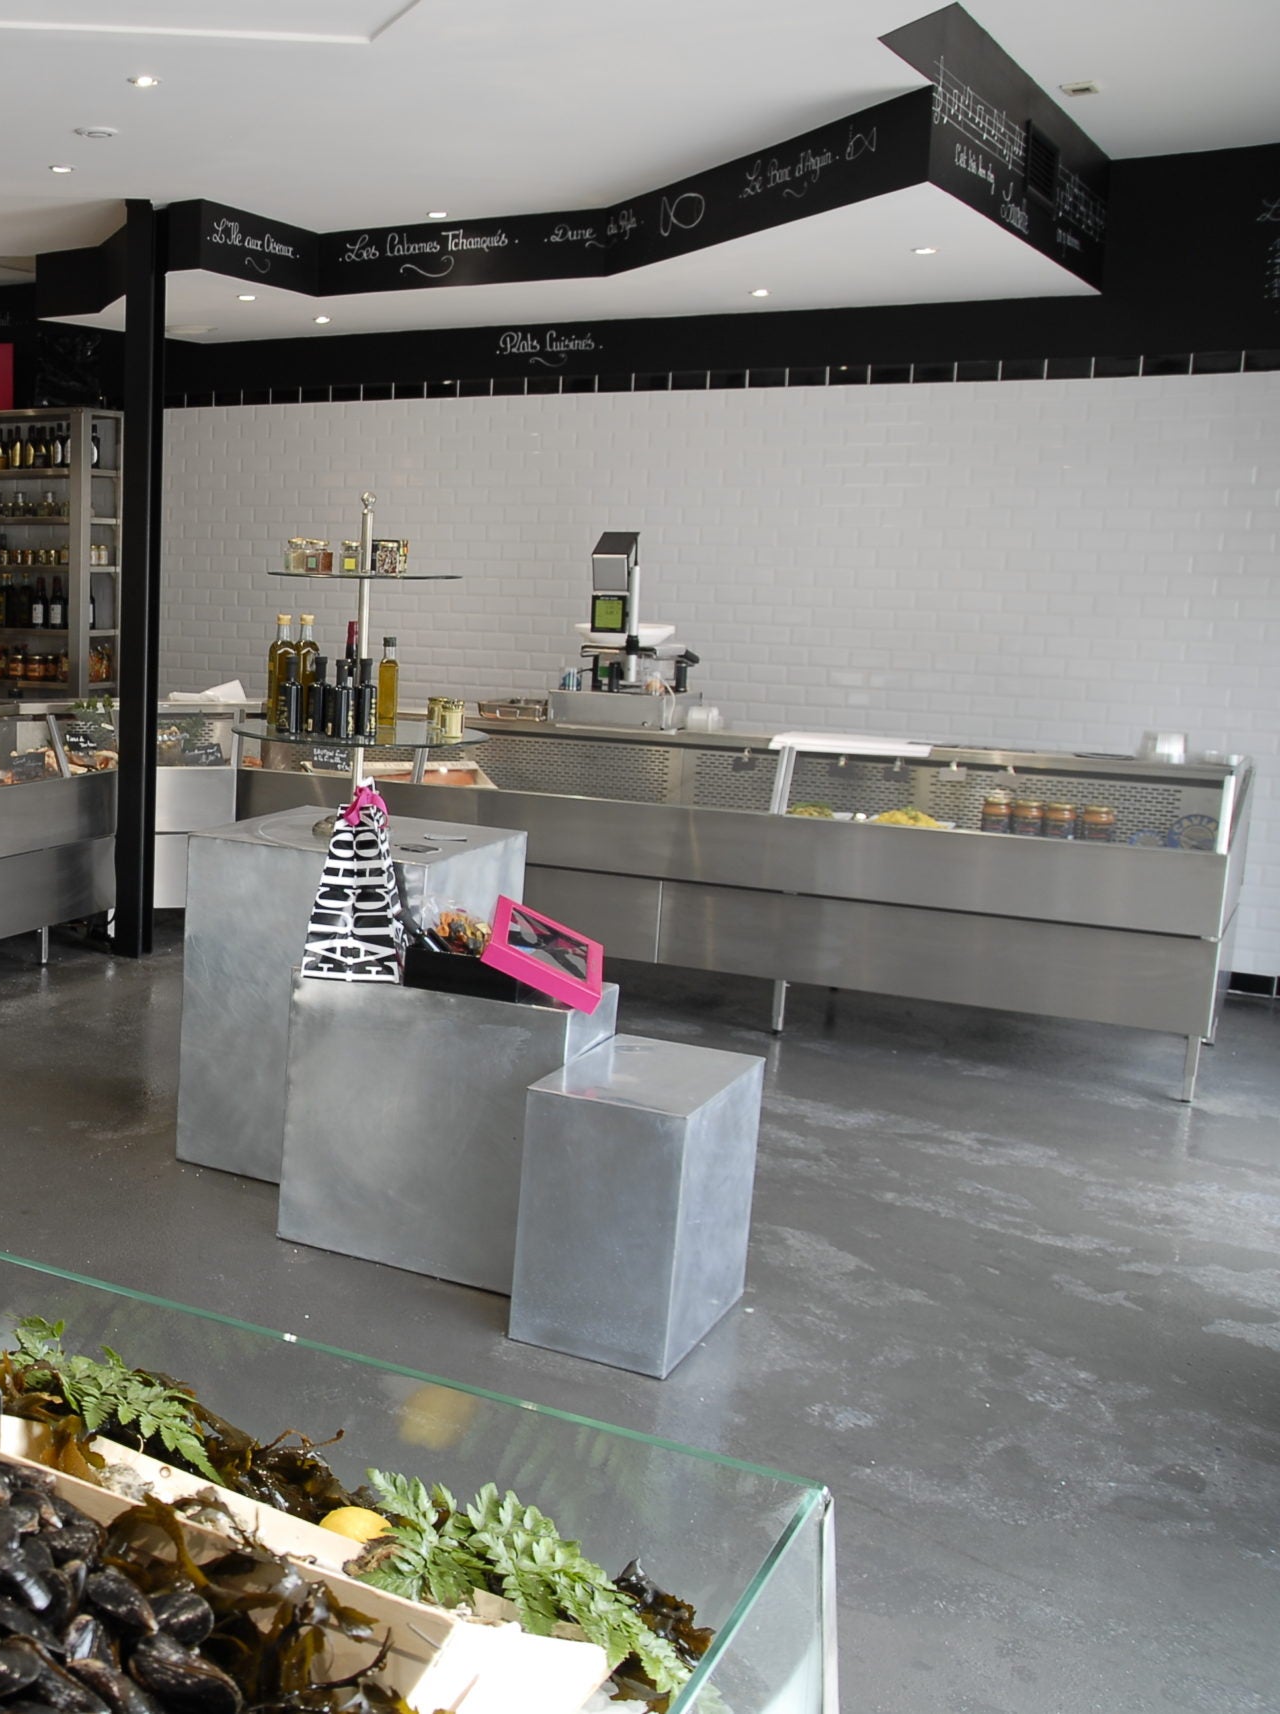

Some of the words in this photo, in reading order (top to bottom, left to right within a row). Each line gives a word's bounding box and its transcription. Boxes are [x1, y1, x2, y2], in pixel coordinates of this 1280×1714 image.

[245, 235, 263, 251] aux
[550, 224, 597, 242] Dune
[345, 234, 380, 262] Les
[385, 232, 440, 258] Cabanes
[500, 331, 540, 355] Plats
